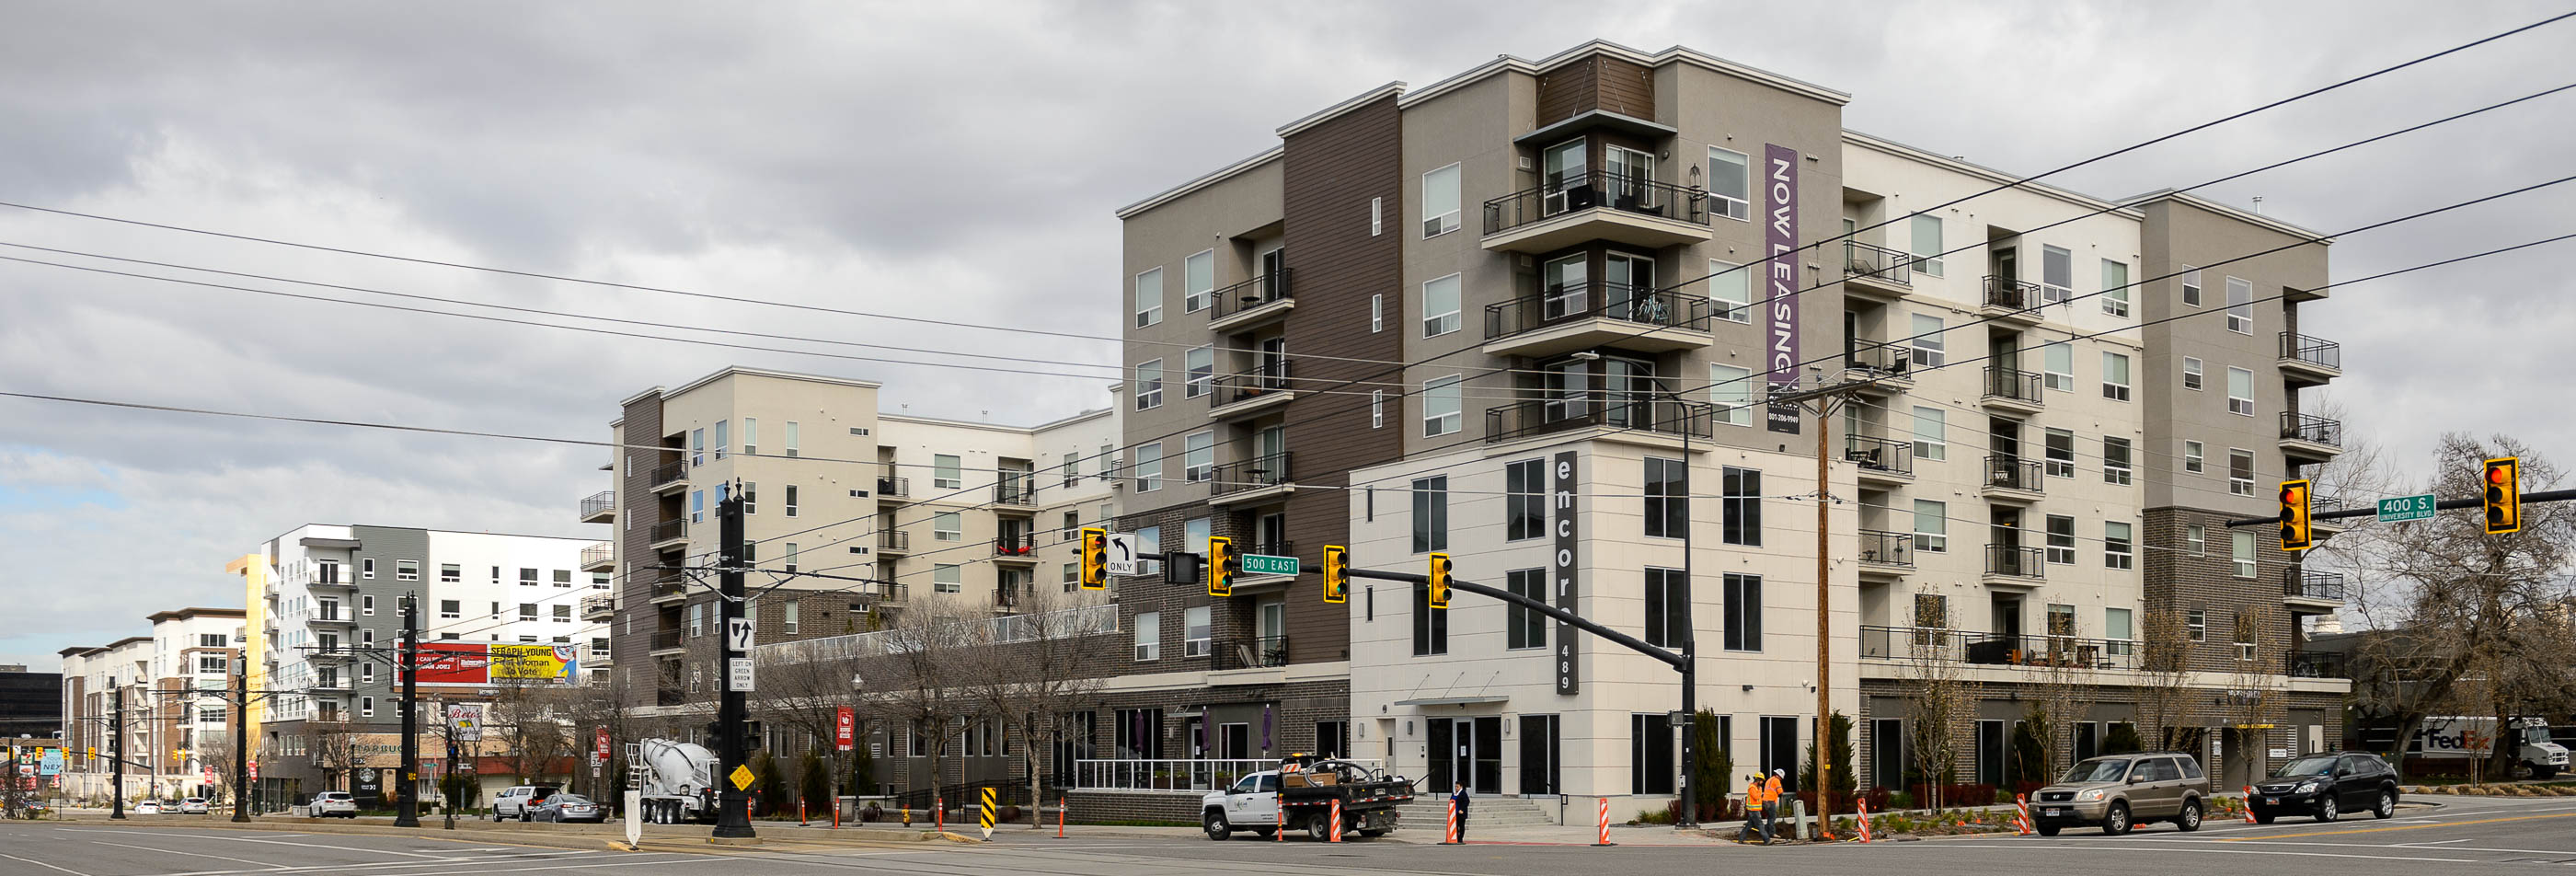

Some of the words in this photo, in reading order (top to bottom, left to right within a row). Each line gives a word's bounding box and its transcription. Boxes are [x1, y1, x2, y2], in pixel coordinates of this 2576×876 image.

[1773, 158, 1790, 238] NOW
[1774, 244, 1791, 375] LEASING
[2384, 499, 2410, 513] 400
[2418, 497, 2429, 510] S.
[2380, 512, 2414, 521] UNIVERSITY
[1110, 562, 1133, 571] ONLY
[1246, 558, 1265, 570] 500
[1271, 560, 1295, 571] EAST
[525, 648, 552, 657] YOUNG
[2429, 730, 2490, 750] FedEx
